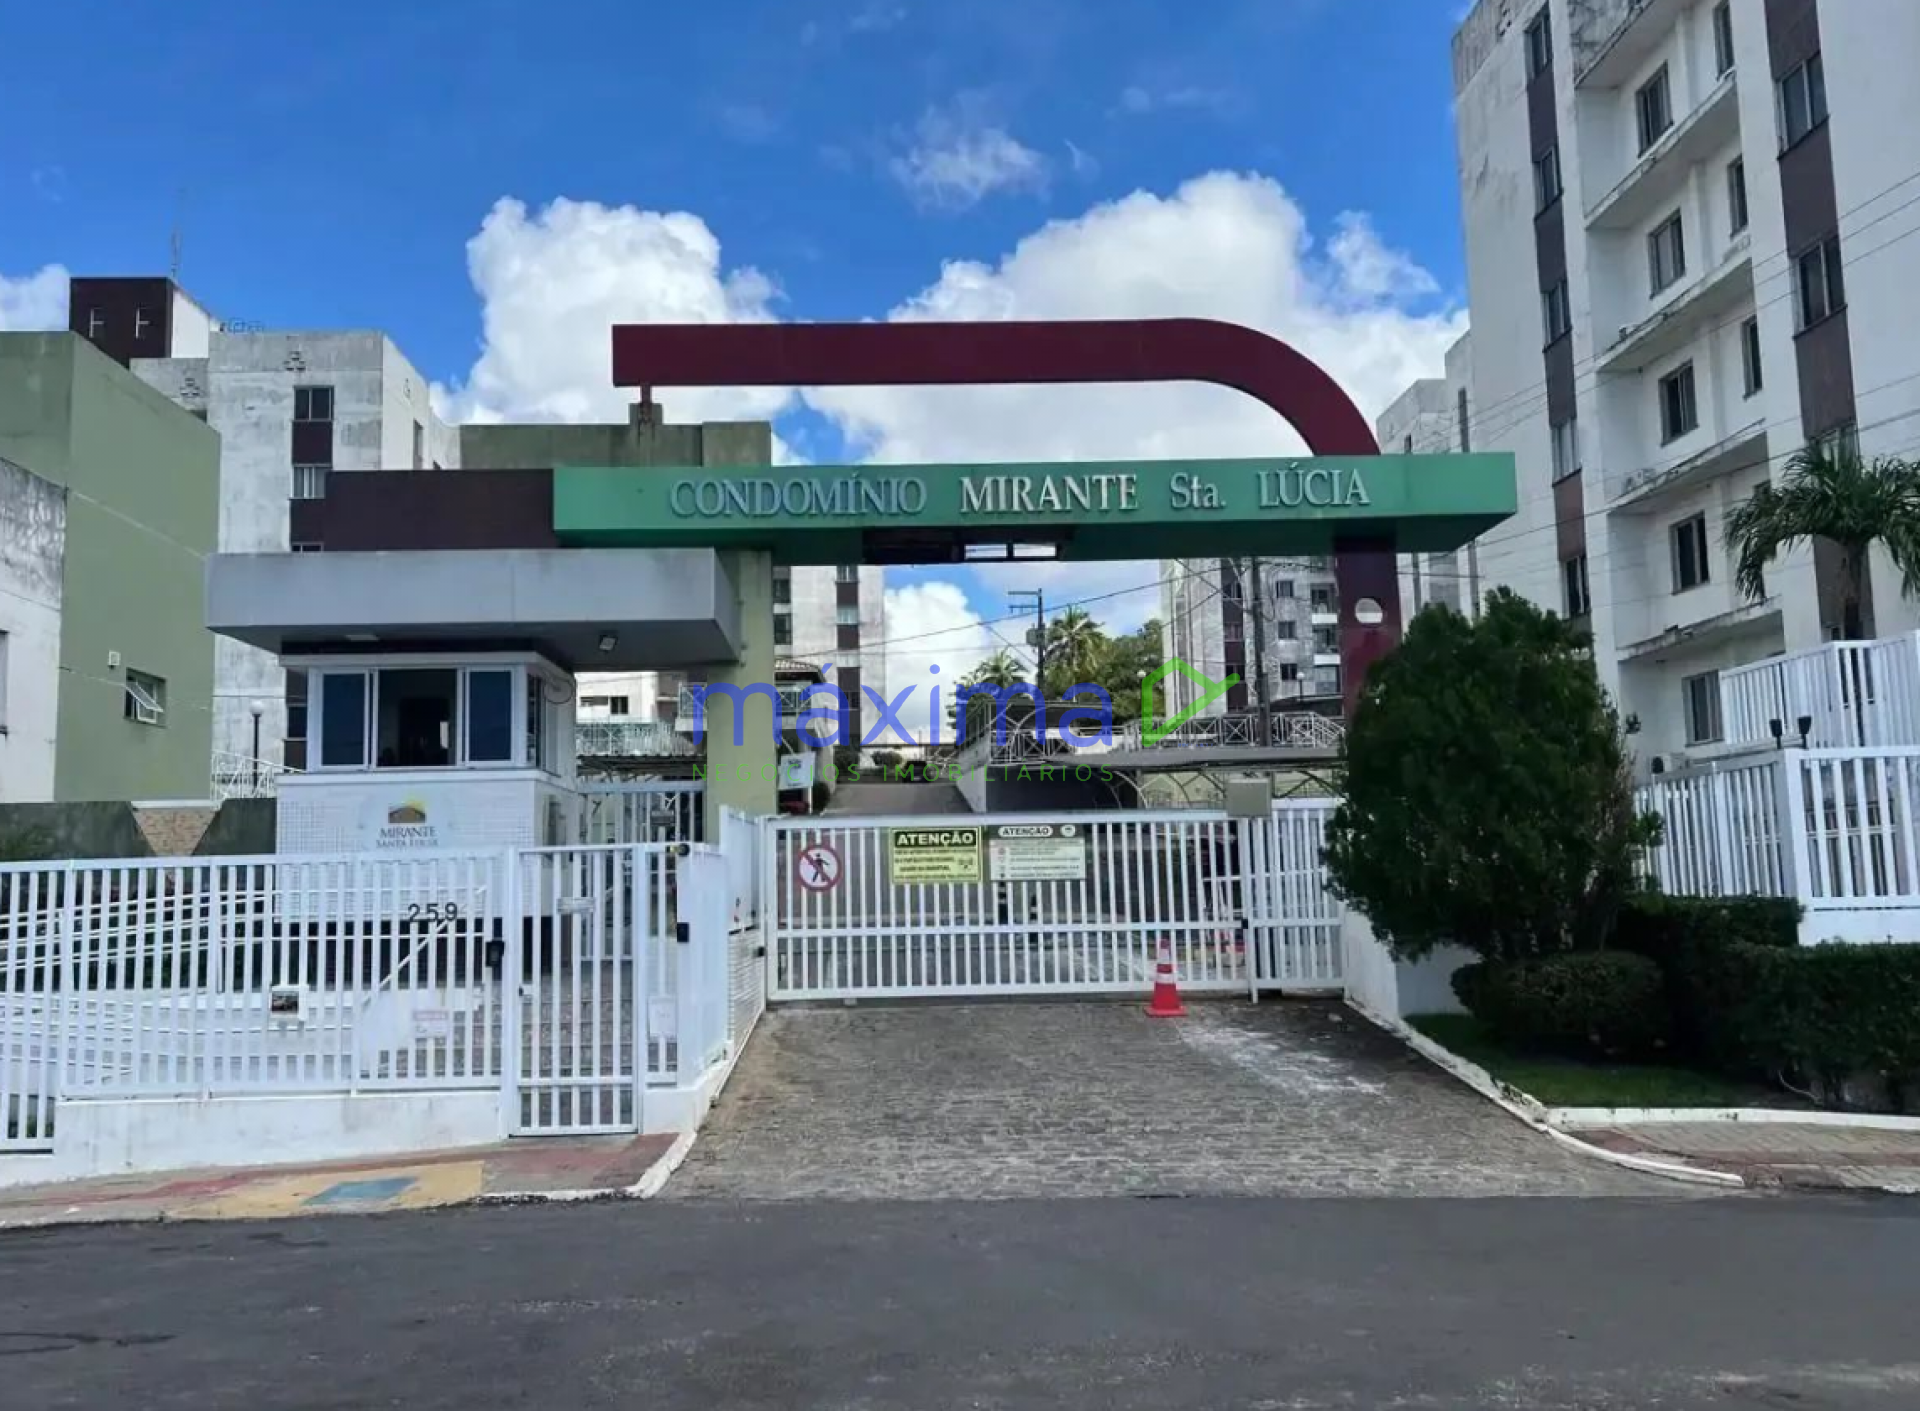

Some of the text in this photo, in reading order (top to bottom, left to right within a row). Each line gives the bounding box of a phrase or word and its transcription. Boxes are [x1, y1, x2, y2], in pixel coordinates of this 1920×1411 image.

[671, 462, 1371, 516] CONDOMÍNIO MIRANTE Sta. LÚCIA
[379, 826, 436, 838] MIRANTE
[897, 831, 974, 847] ATENÇÃO
[408, 902, 457, 922] 259
